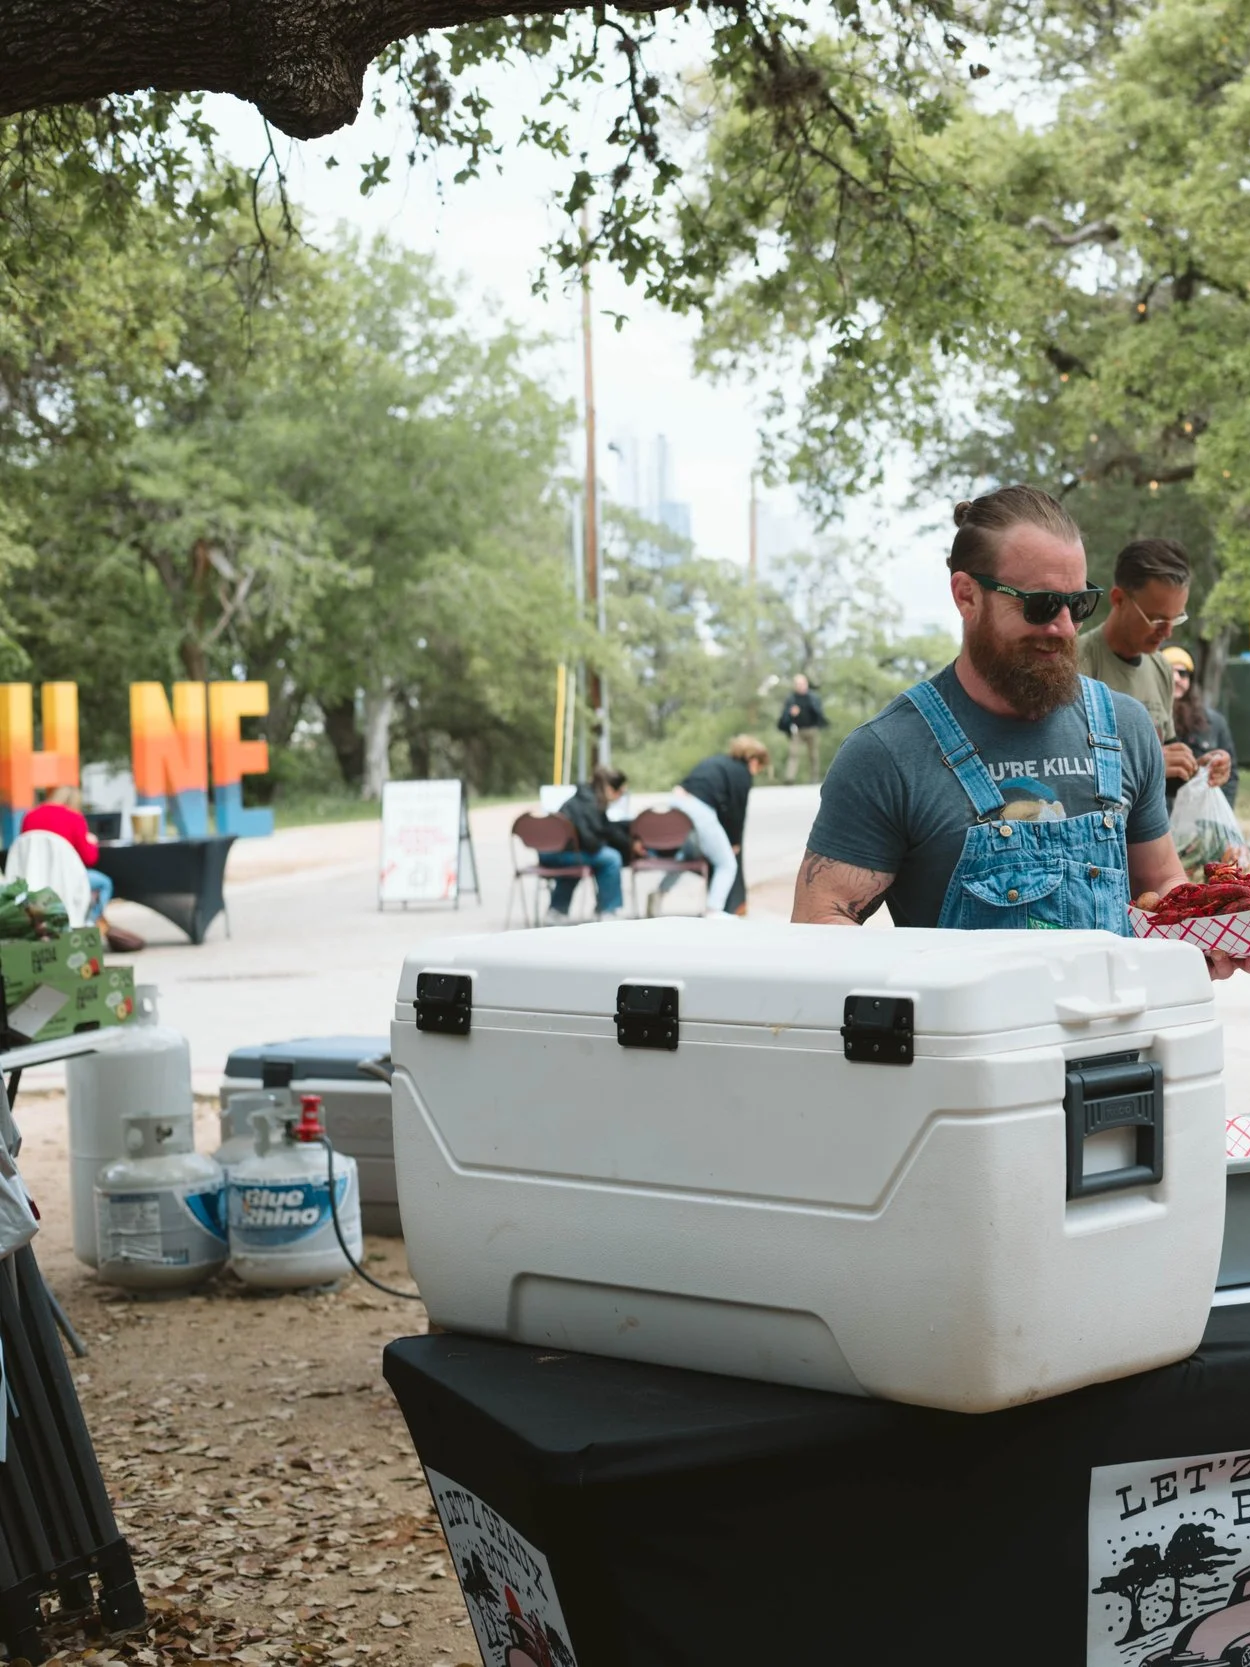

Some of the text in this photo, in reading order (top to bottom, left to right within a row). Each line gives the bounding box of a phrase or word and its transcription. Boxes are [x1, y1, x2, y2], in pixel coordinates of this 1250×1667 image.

[988, 760, 1039, 781] U'RE
[246, 1188, 305, 1207] Blue
[481, 1503, 549, 1602] GEAUX
